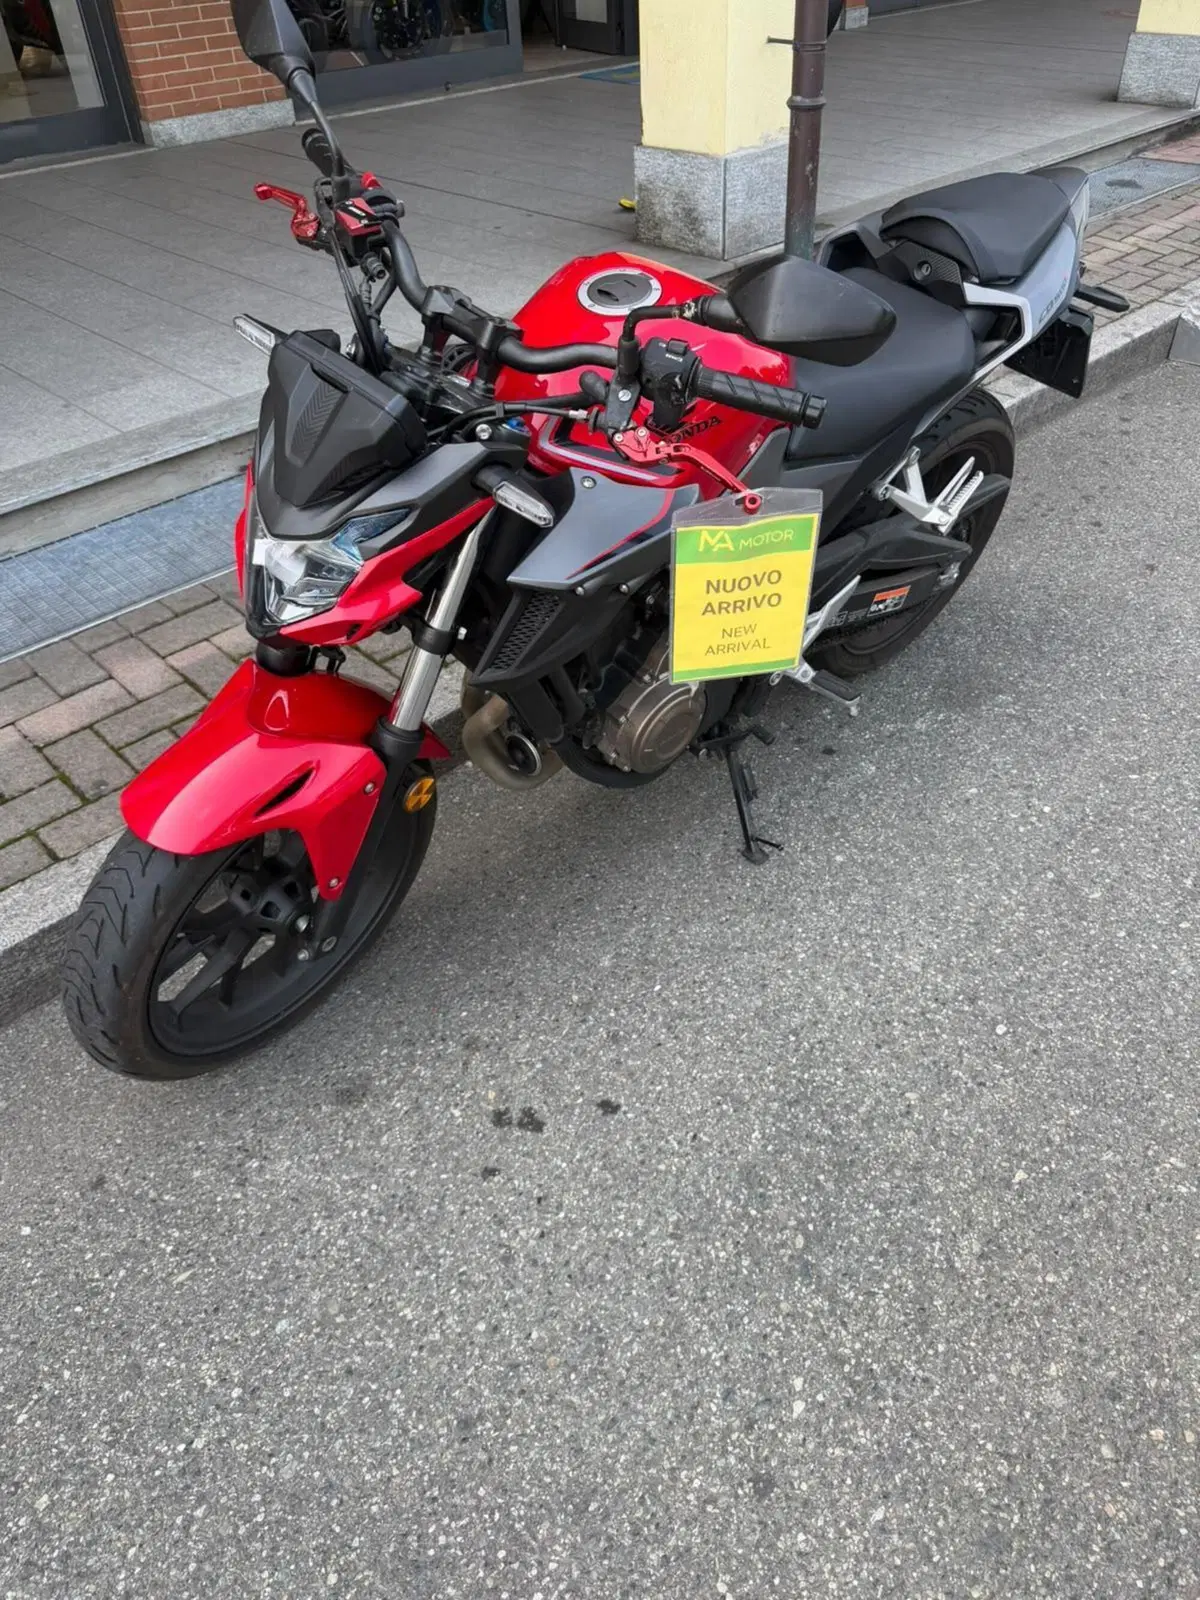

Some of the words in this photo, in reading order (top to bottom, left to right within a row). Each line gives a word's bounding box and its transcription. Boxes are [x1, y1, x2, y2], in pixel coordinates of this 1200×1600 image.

[666, 416, 721, 444] ONDA
[699, 530, 734, 552] MA
[739, 529, 794, 550] MOTOR
[706, 569, 782, 594] NUOVO
[702, 593, 782, 616] ARRIVO
[721, 623, 757, 639] NEW
[705, 638, 770, 656] ARRIVAL
